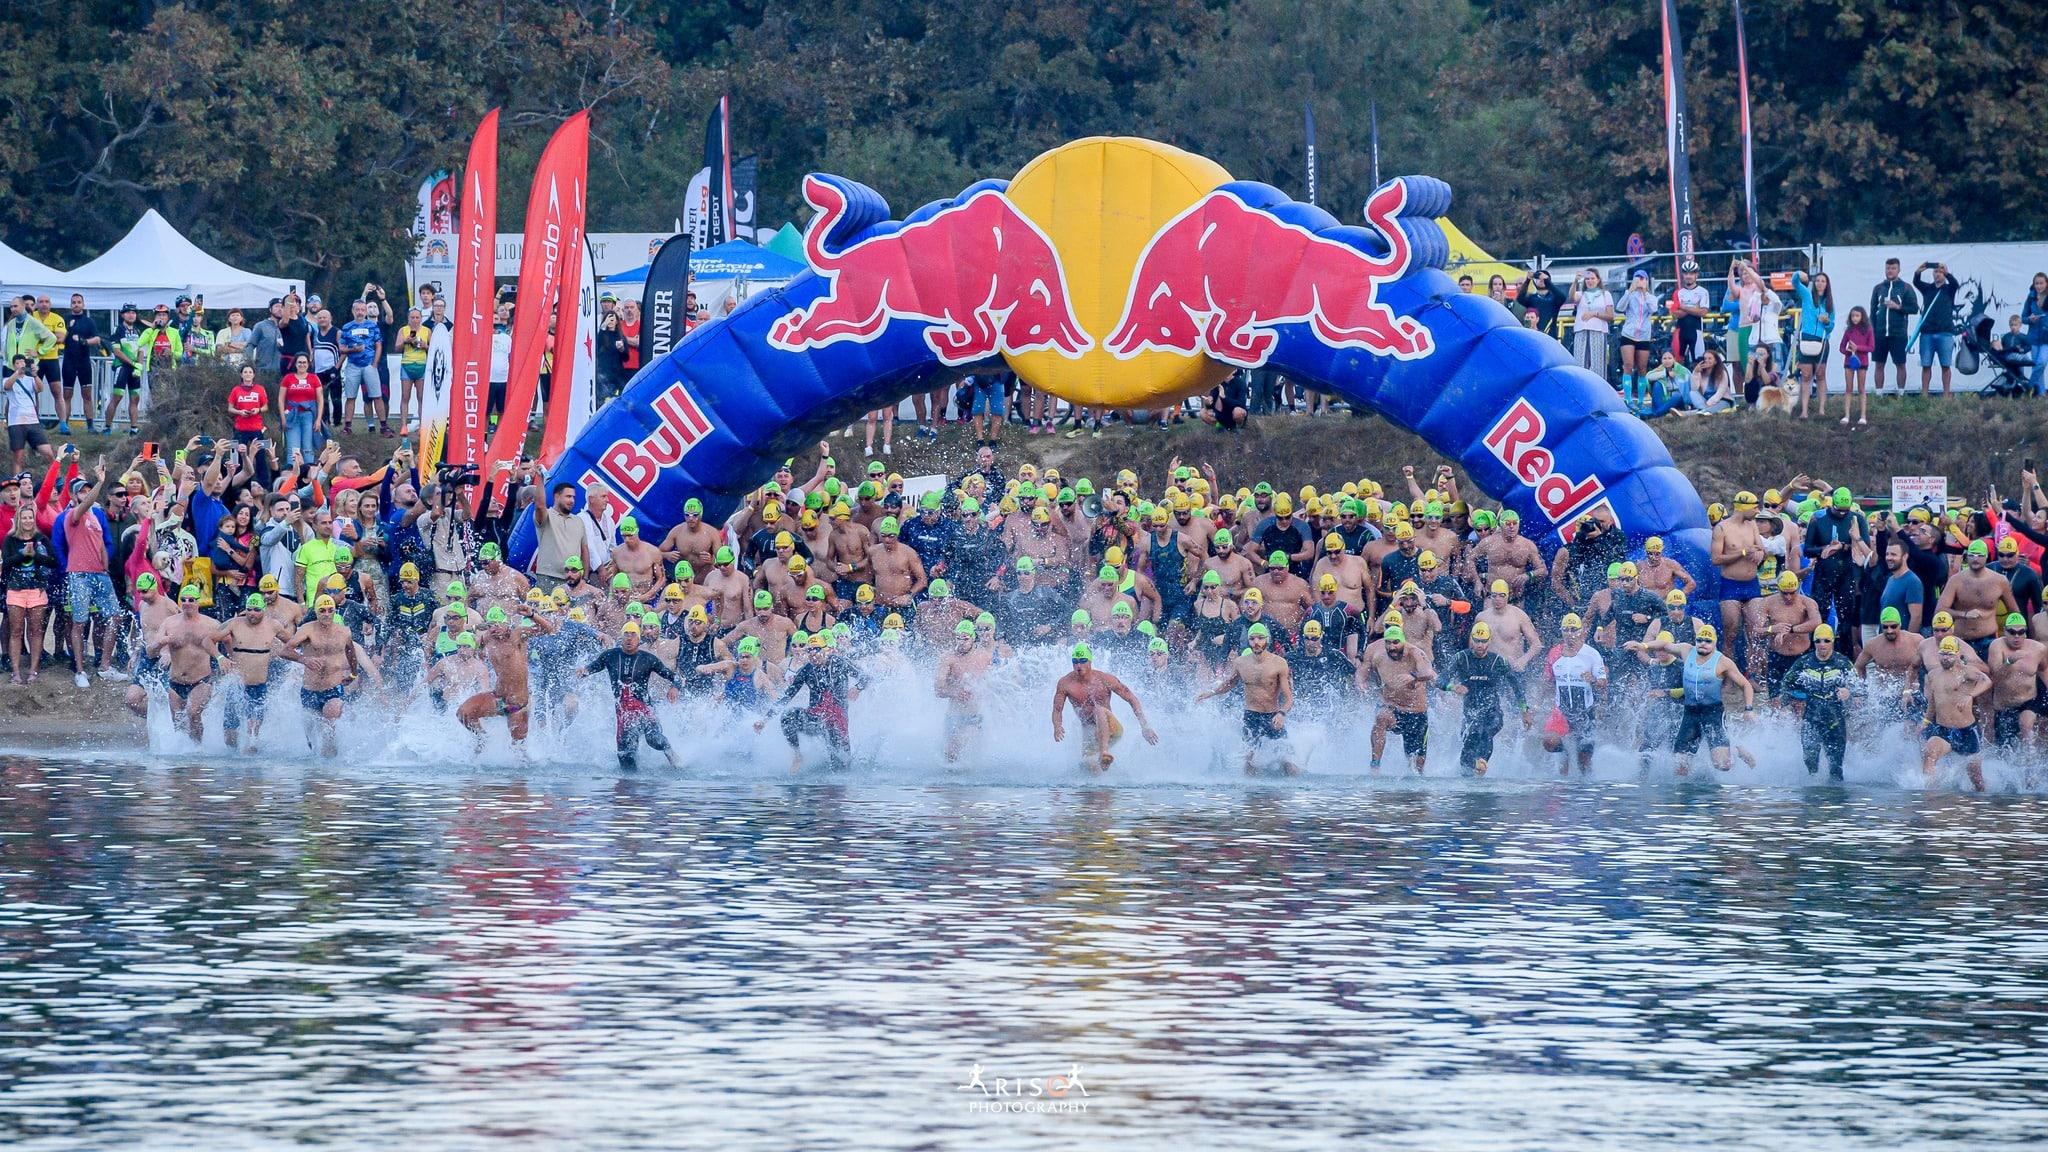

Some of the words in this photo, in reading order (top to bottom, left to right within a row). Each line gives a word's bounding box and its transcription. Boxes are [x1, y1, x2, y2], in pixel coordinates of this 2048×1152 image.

[712, 195, 720, 235] DEPOT
[598, 384, 712, 500] Bull
[1484, 399, 1603, 521] Red
